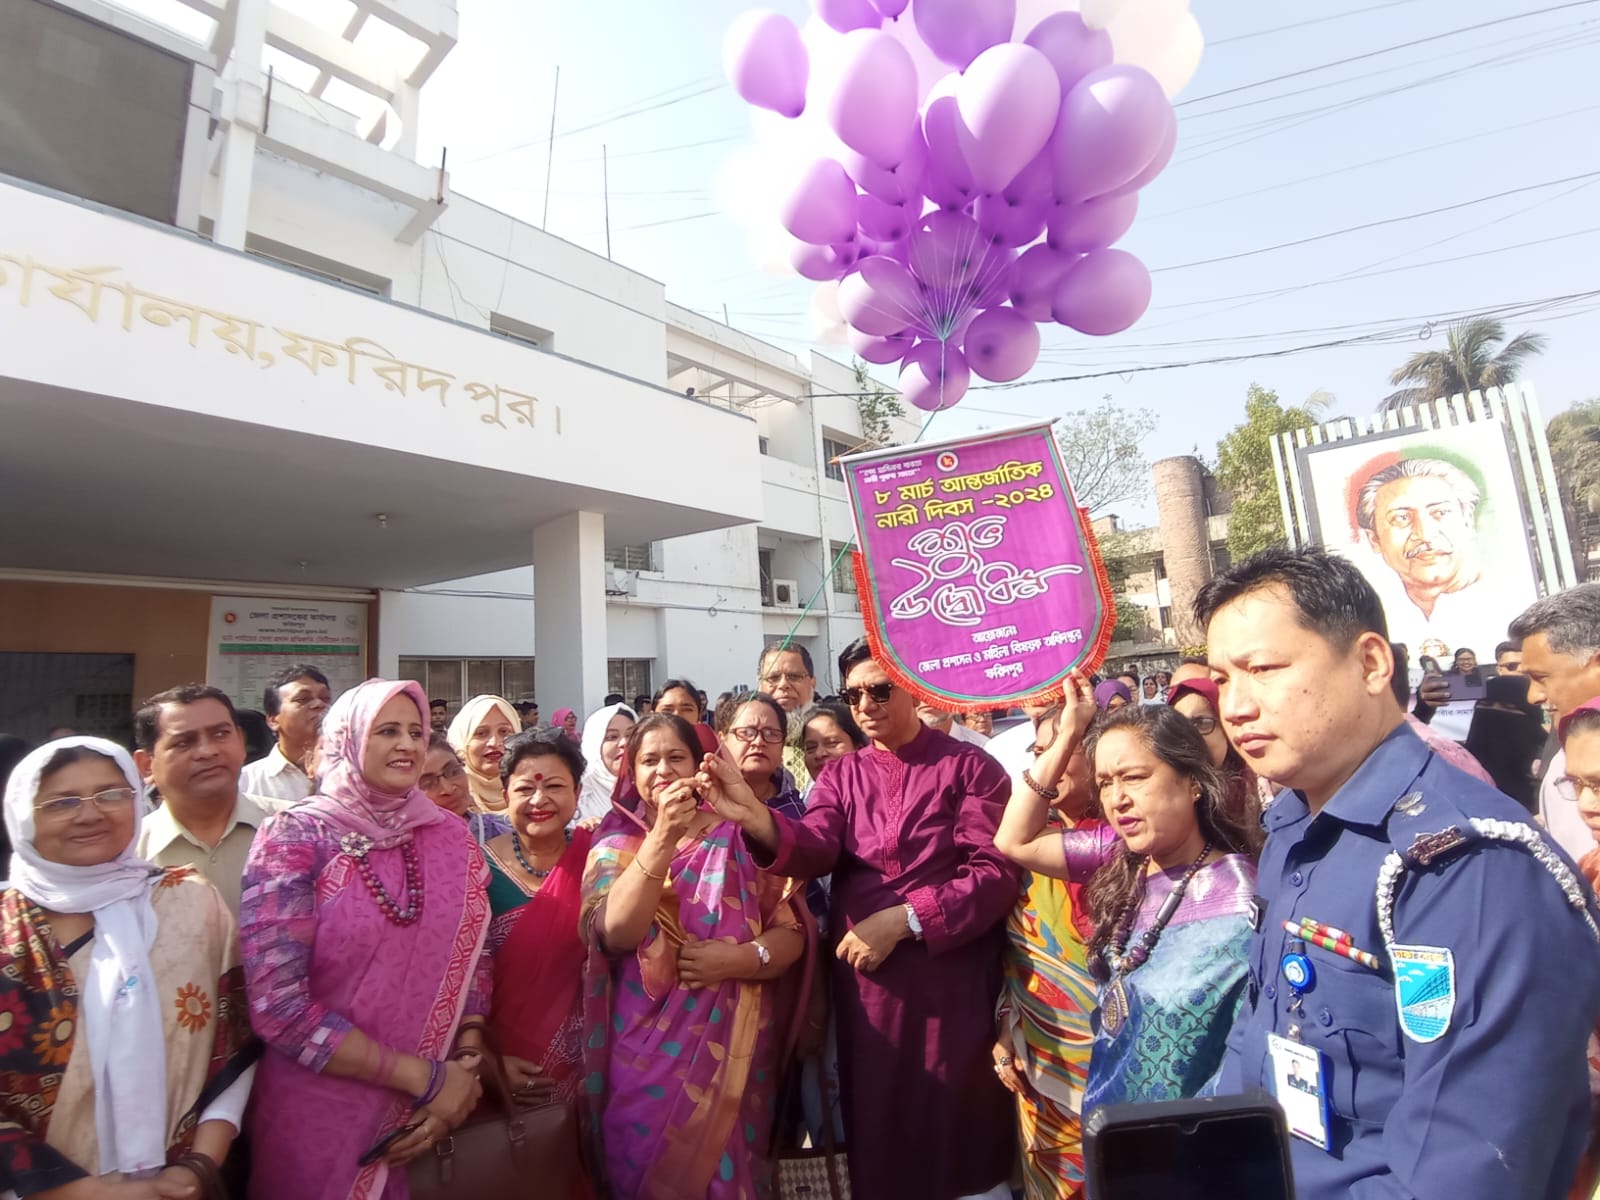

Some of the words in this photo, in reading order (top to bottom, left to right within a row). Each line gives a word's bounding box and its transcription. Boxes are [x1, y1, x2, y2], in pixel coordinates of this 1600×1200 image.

[874, 489, 892, 505] ৮
[897, 478, 935, 502] মার্চ
[939, 459, 1043, 495] আন্তর্জাতিক
[875, 503, 920, 530] নারী
[924, 497, 974, 523] দিবস
[908, 515, 1007, 579] শুভ
[984, 661, 1024, 681] ফরিদপুর
